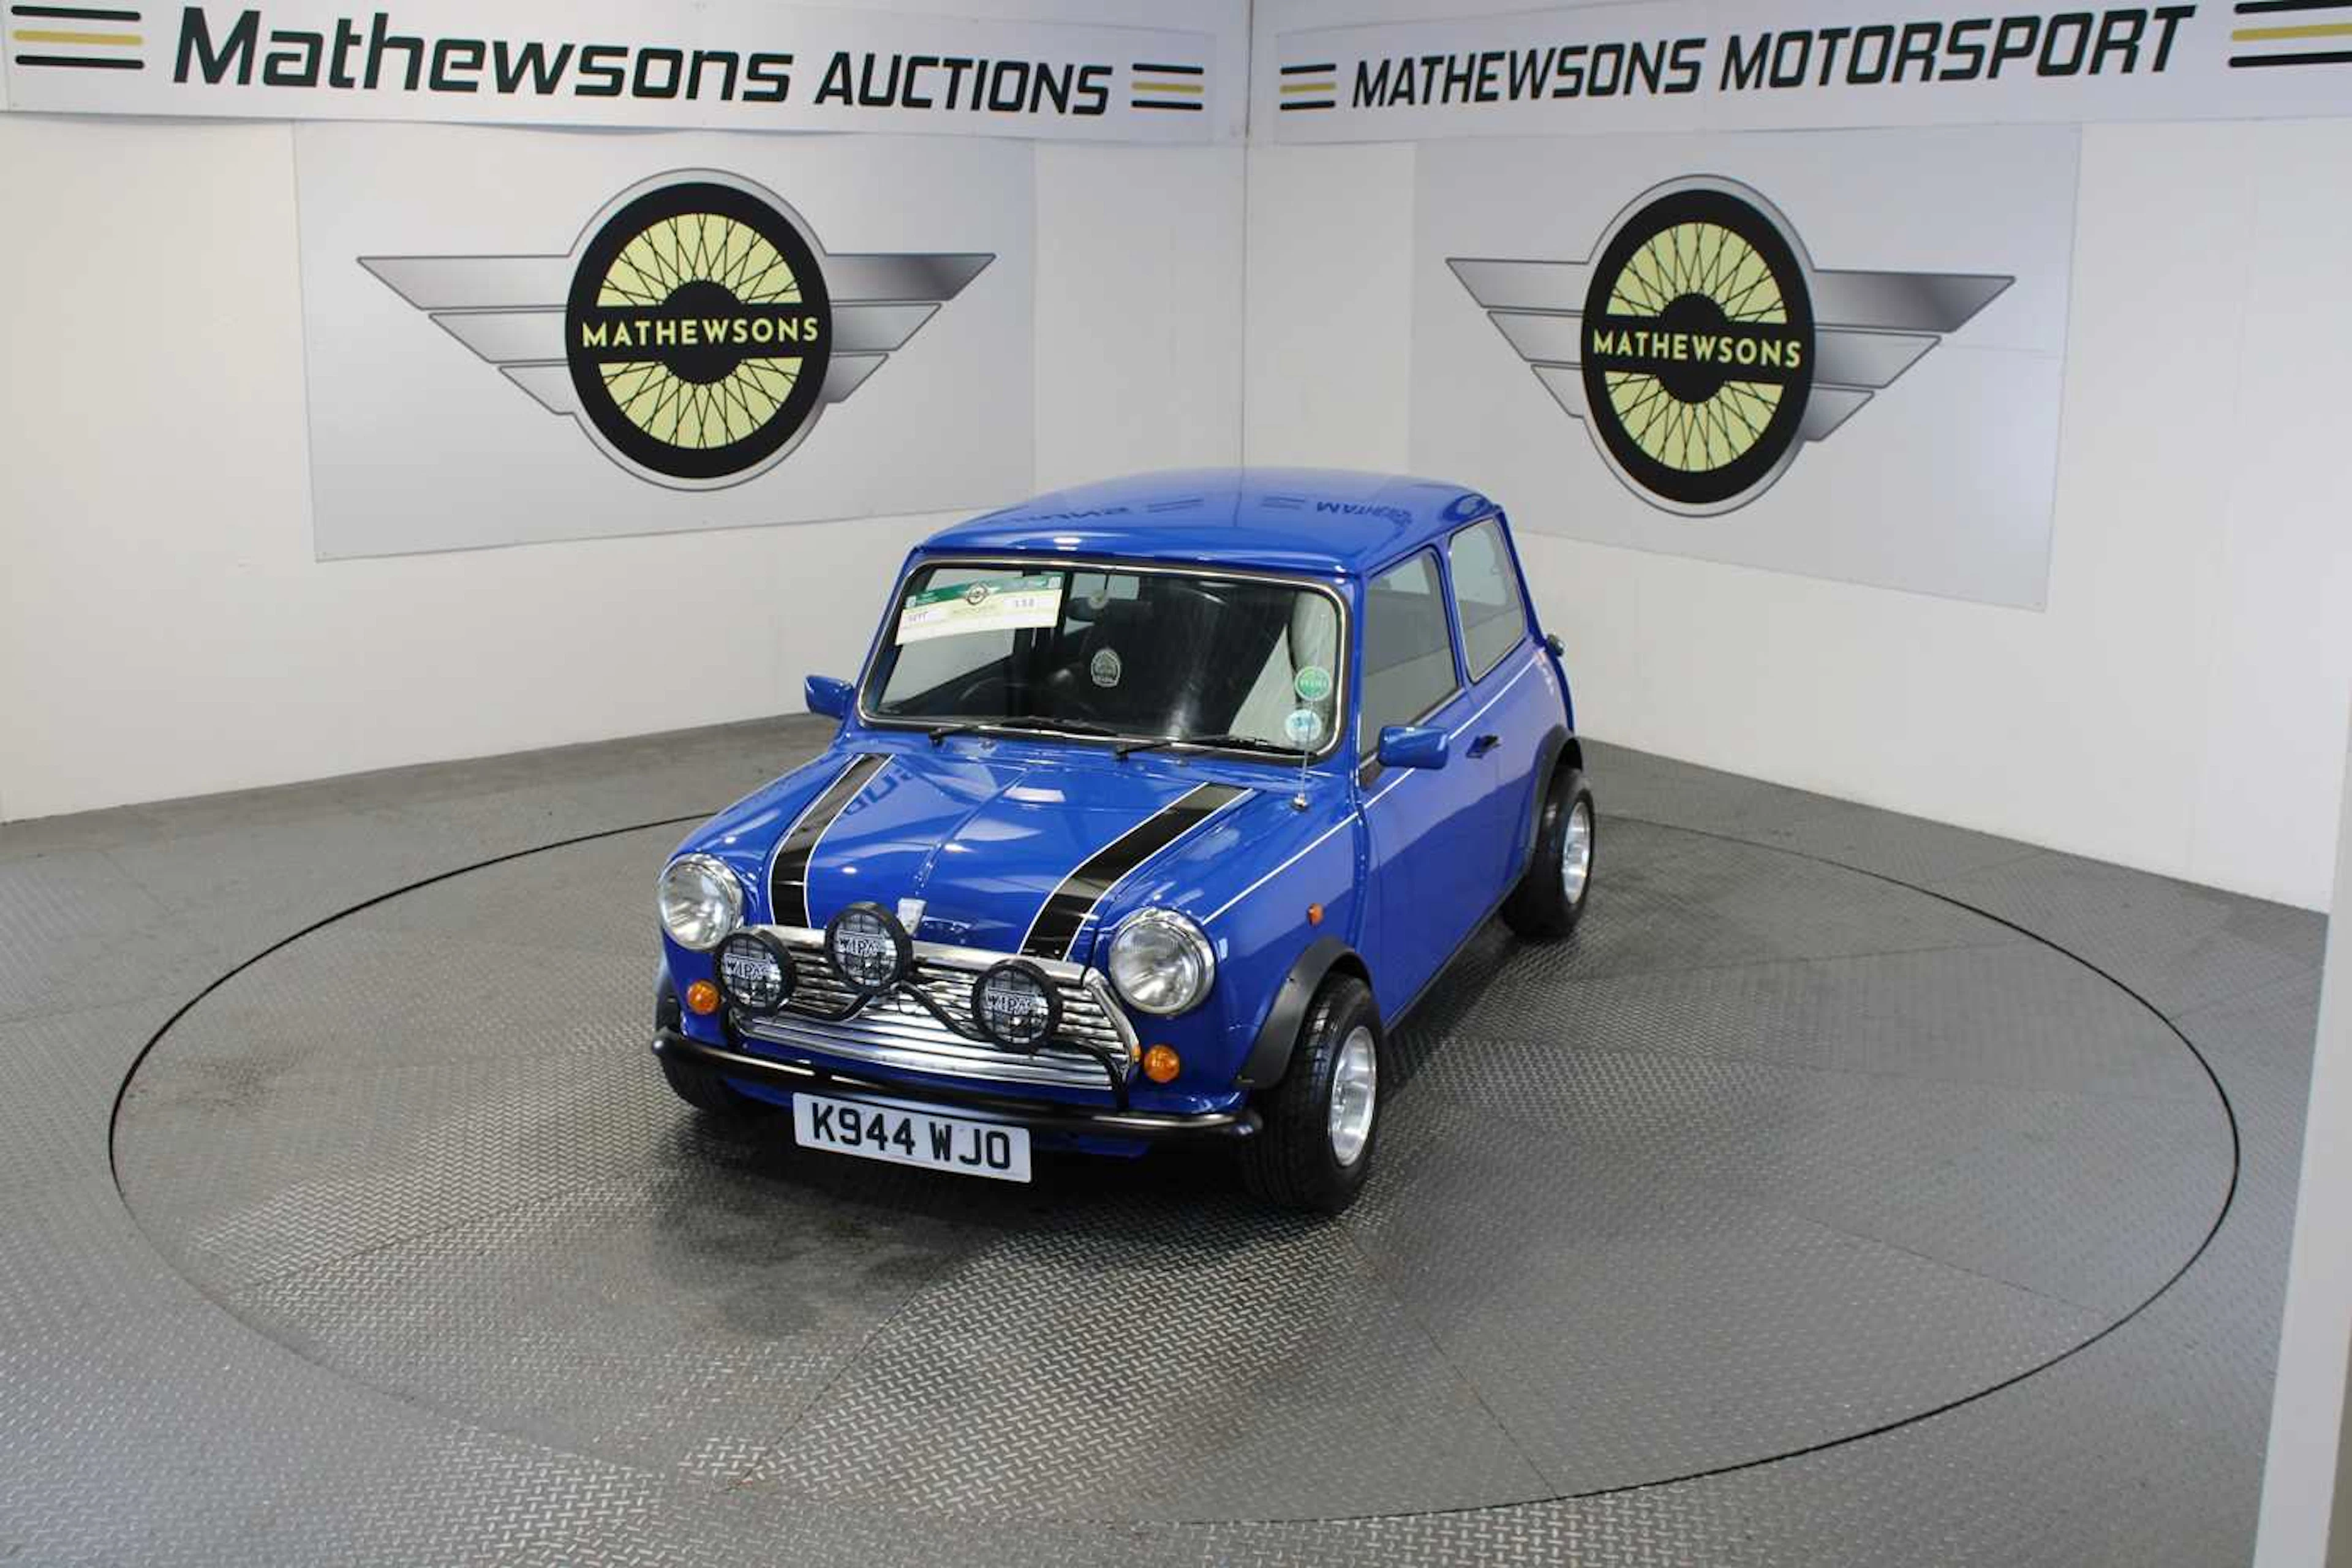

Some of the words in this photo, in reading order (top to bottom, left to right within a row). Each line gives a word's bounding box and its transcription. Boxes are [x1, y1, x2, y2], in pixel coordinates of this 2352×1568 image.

[174, 7, 793, 102] Mathewsons
[815, 52, 1113, 115] AUCTIONS
[1352, 38, 1706, 108] MATHEWSONS
[1720, 5, 2196, 91] MOTORSPORT
[582, 318, 818, 347] MATHEWSONS
[1594, 331, 1800, 367] MATHEWSONS
[812, 1102, 916, 1156] K944
[929, 1121, 1011, 1170] WJO
